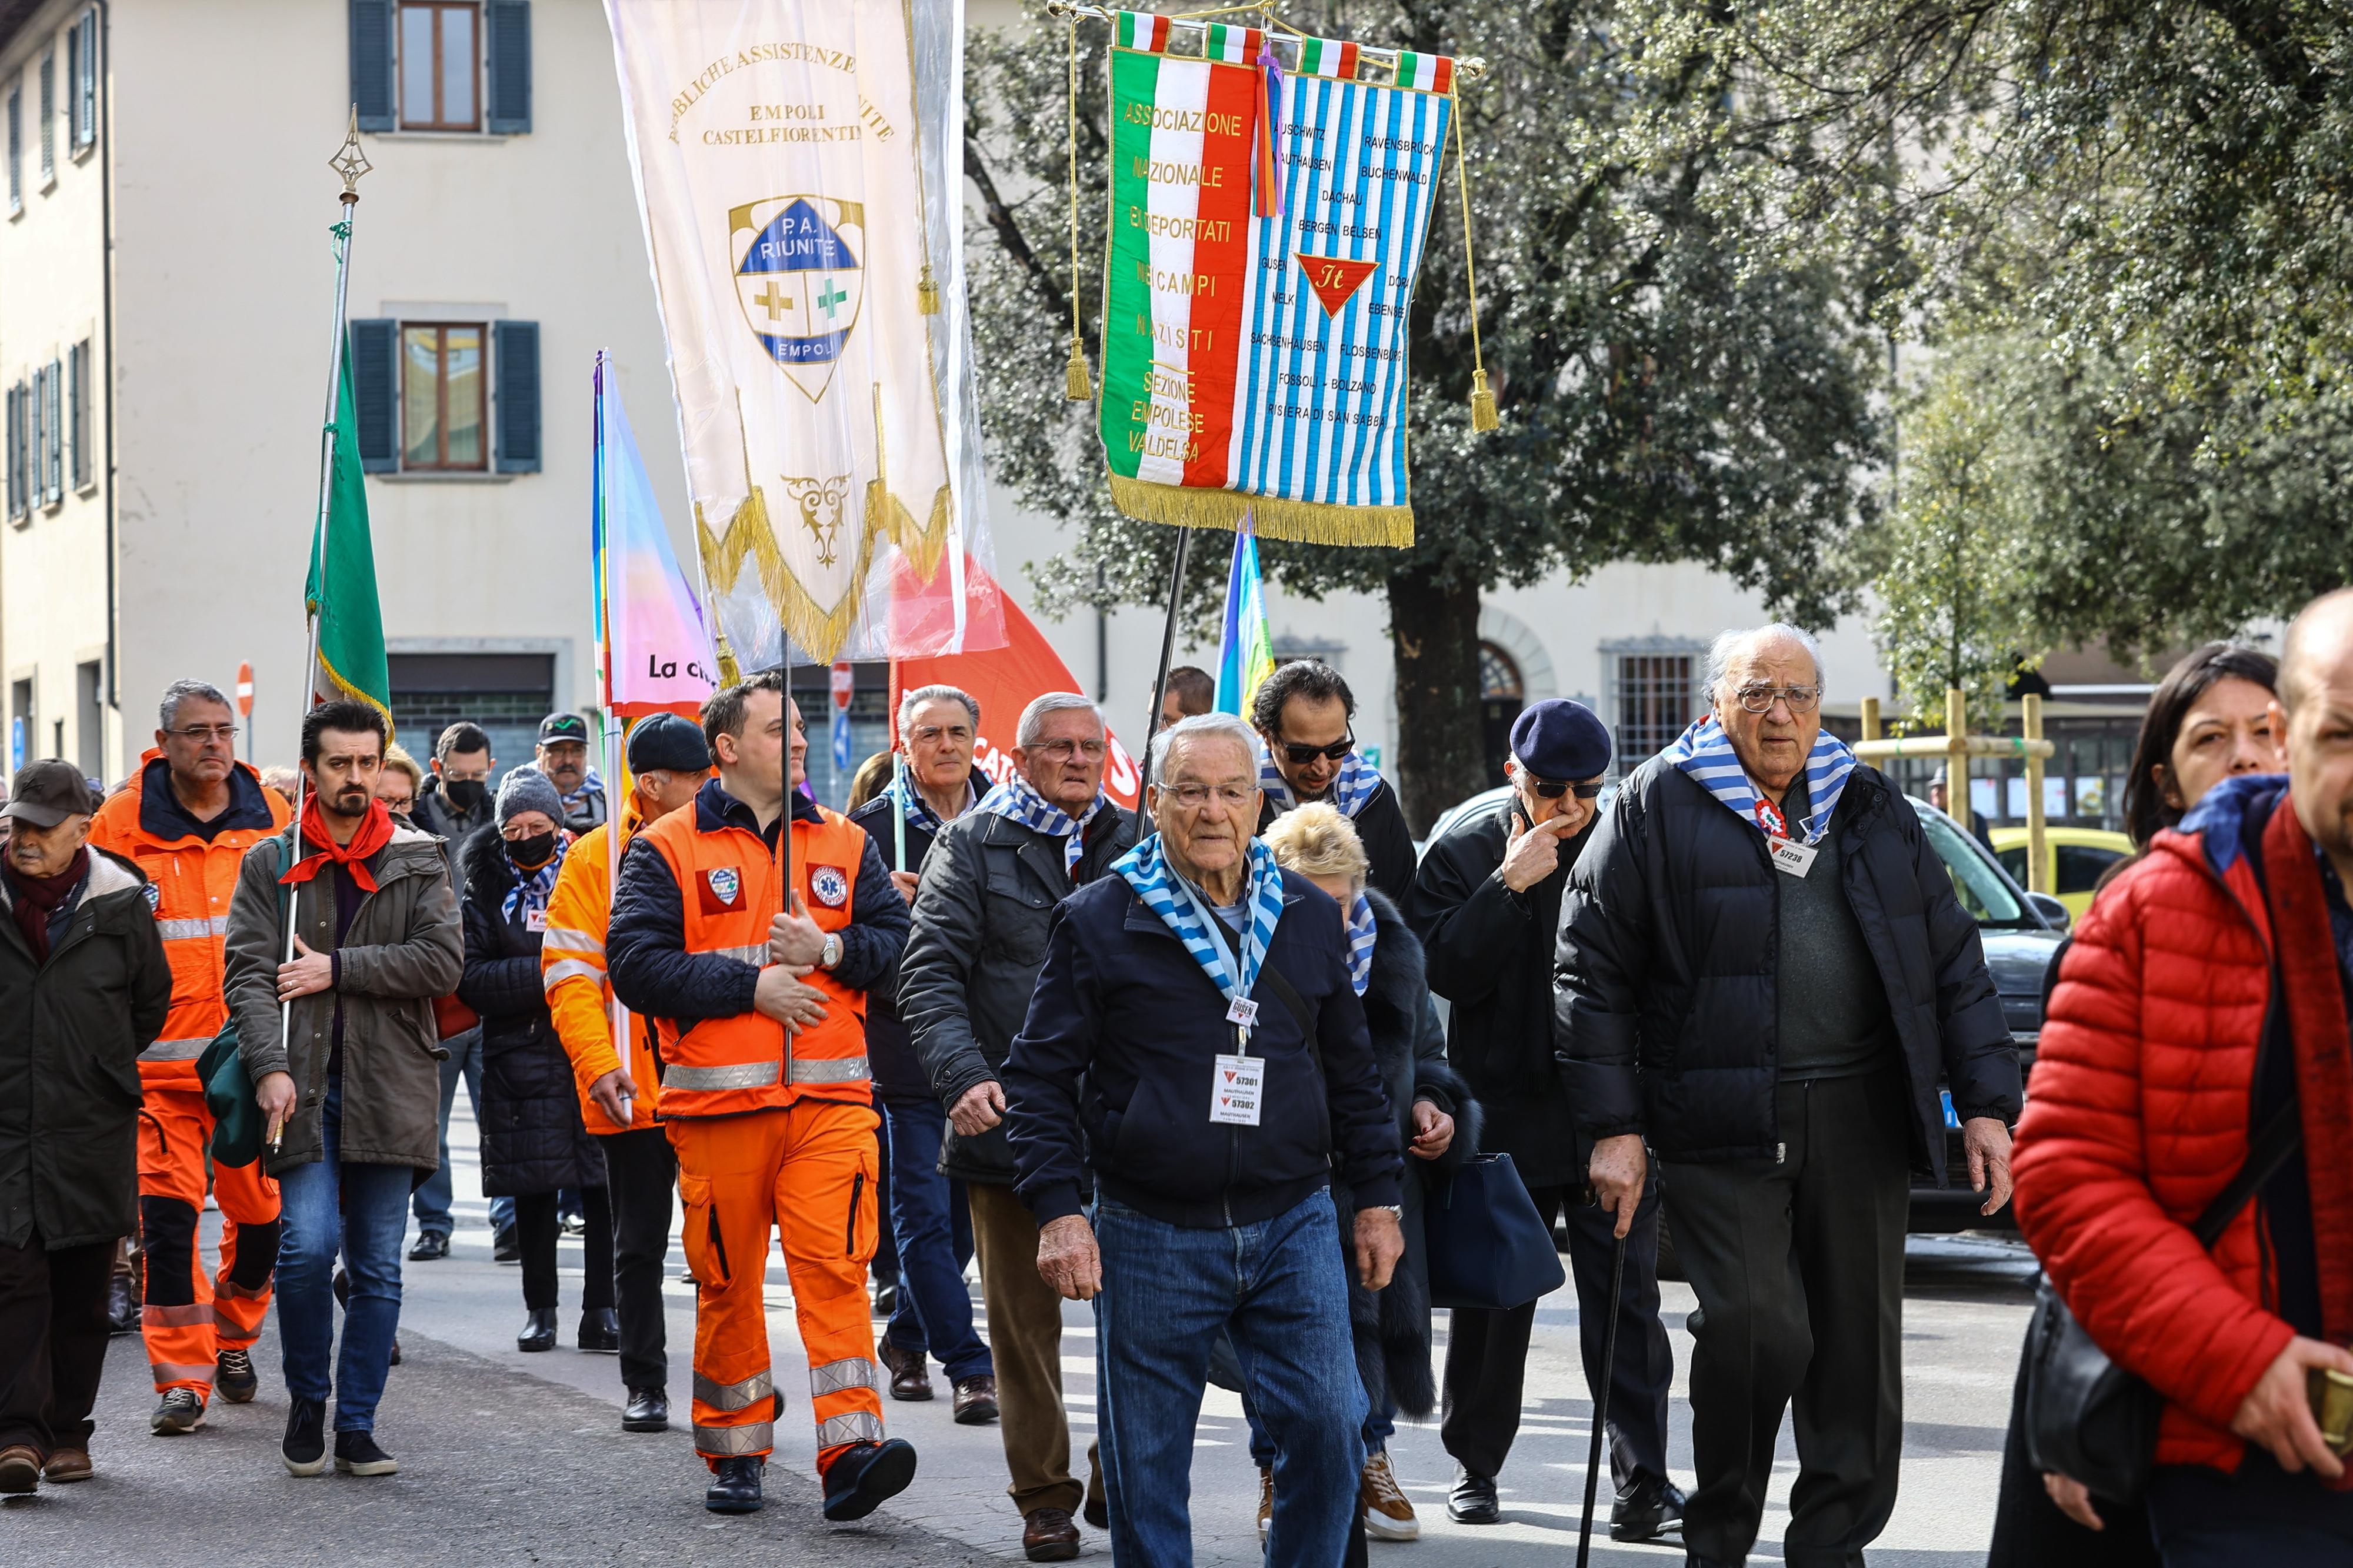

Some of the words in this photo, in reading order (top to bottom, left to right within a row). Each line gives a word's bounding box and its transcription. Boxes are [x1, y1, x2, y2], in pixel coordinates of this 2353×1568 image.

[736, 42, 856, 74] ASSISTENZE
[749, 104, 825, 121] EMPOLI
[1124, 102, 1242, 136] ASSOCIAZIONE
[1132, 155, 1224, 188] NAZIONALE
[1361, 166, 1427, 185] BUCHENWALD
[1322, 190, 1362, 206] DACHAU
[1144, 212, 1231, 243] DEPORTATI
[1298, 219, 1338, 236] BERGEN
[1342, 225, 1382, 241] BELSEN
[761, 238, 835, 259] RIUNITE
[1261, 257, 1288, 273] GUSEN
[1156, 271, 1216, 297] CAMPI
[1272, 291, 1295, 305] MELK
[1136, 313, 1212, 352] NAZISTI
[1251, 332, 1325, 353] SACHSENHAUSEN
[1144, 371, 1196, 403] SEZIONE
[1279, 372, 1318, 388] FOSSOLI
[1331, 378, 1377, 395] BOLZANO
[1132, 400, 1204, 433] EMPOLESE
[1268, 403, 1309, 420] RISIERA
[1312, 409, 1324, 421] DI
[1328, 410, 1349, 423] SAN
[1352, 413, 1385, 428] SABBA
[1129, 430, 1199, 463] VALDELSA
[649, 653, 677, 679] La
[1779, 849, 1802, 863] 57238
[1233, 1001, 1254, 1016] GUSEN
[1236, 1076, 1258, 1086] 57301
[1232, 1099, 1255, 1110] 57302
